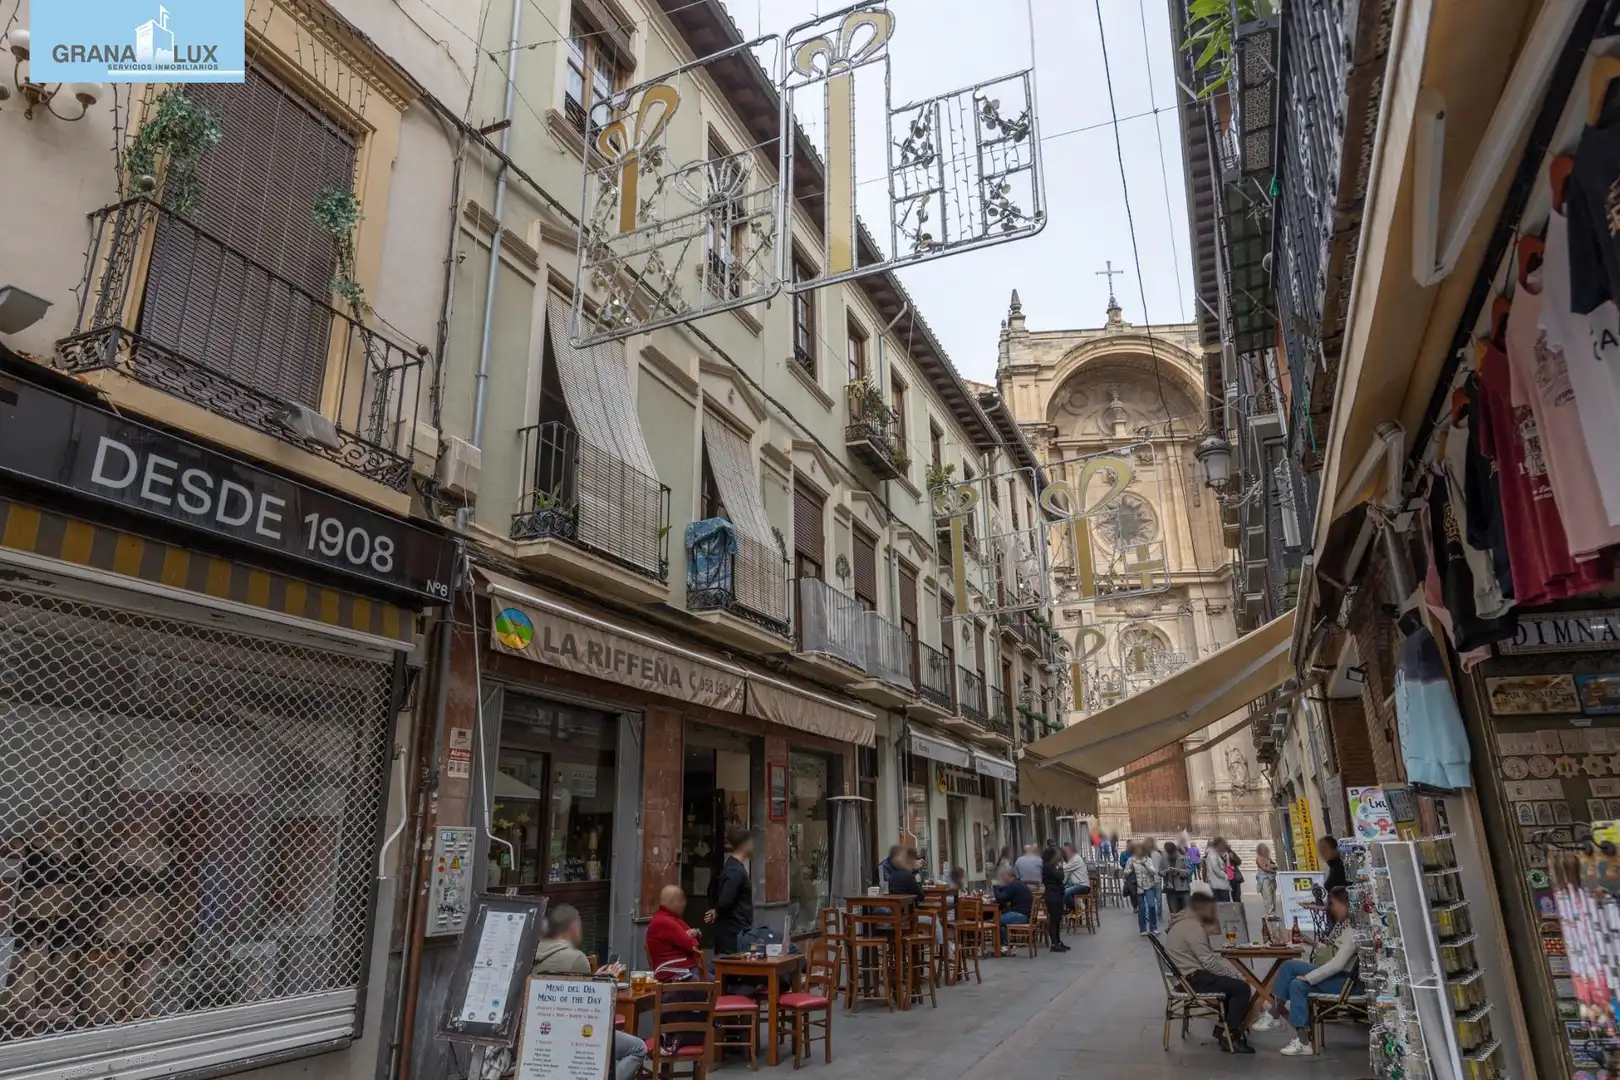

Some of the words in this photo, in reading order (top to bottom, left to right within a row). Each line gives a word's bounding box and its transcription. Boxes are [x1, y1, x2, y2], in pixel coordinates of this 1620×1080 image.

[90, 436, 287, 540] DESDE
[303, 512, 394, 573] 1908
[544, 626, 578, 666] LA
[587, 639, 683, 690] RIFFEÑA
[537, 993, 556, 1003] MENU
[587, 996, 602, 1005] DAY
